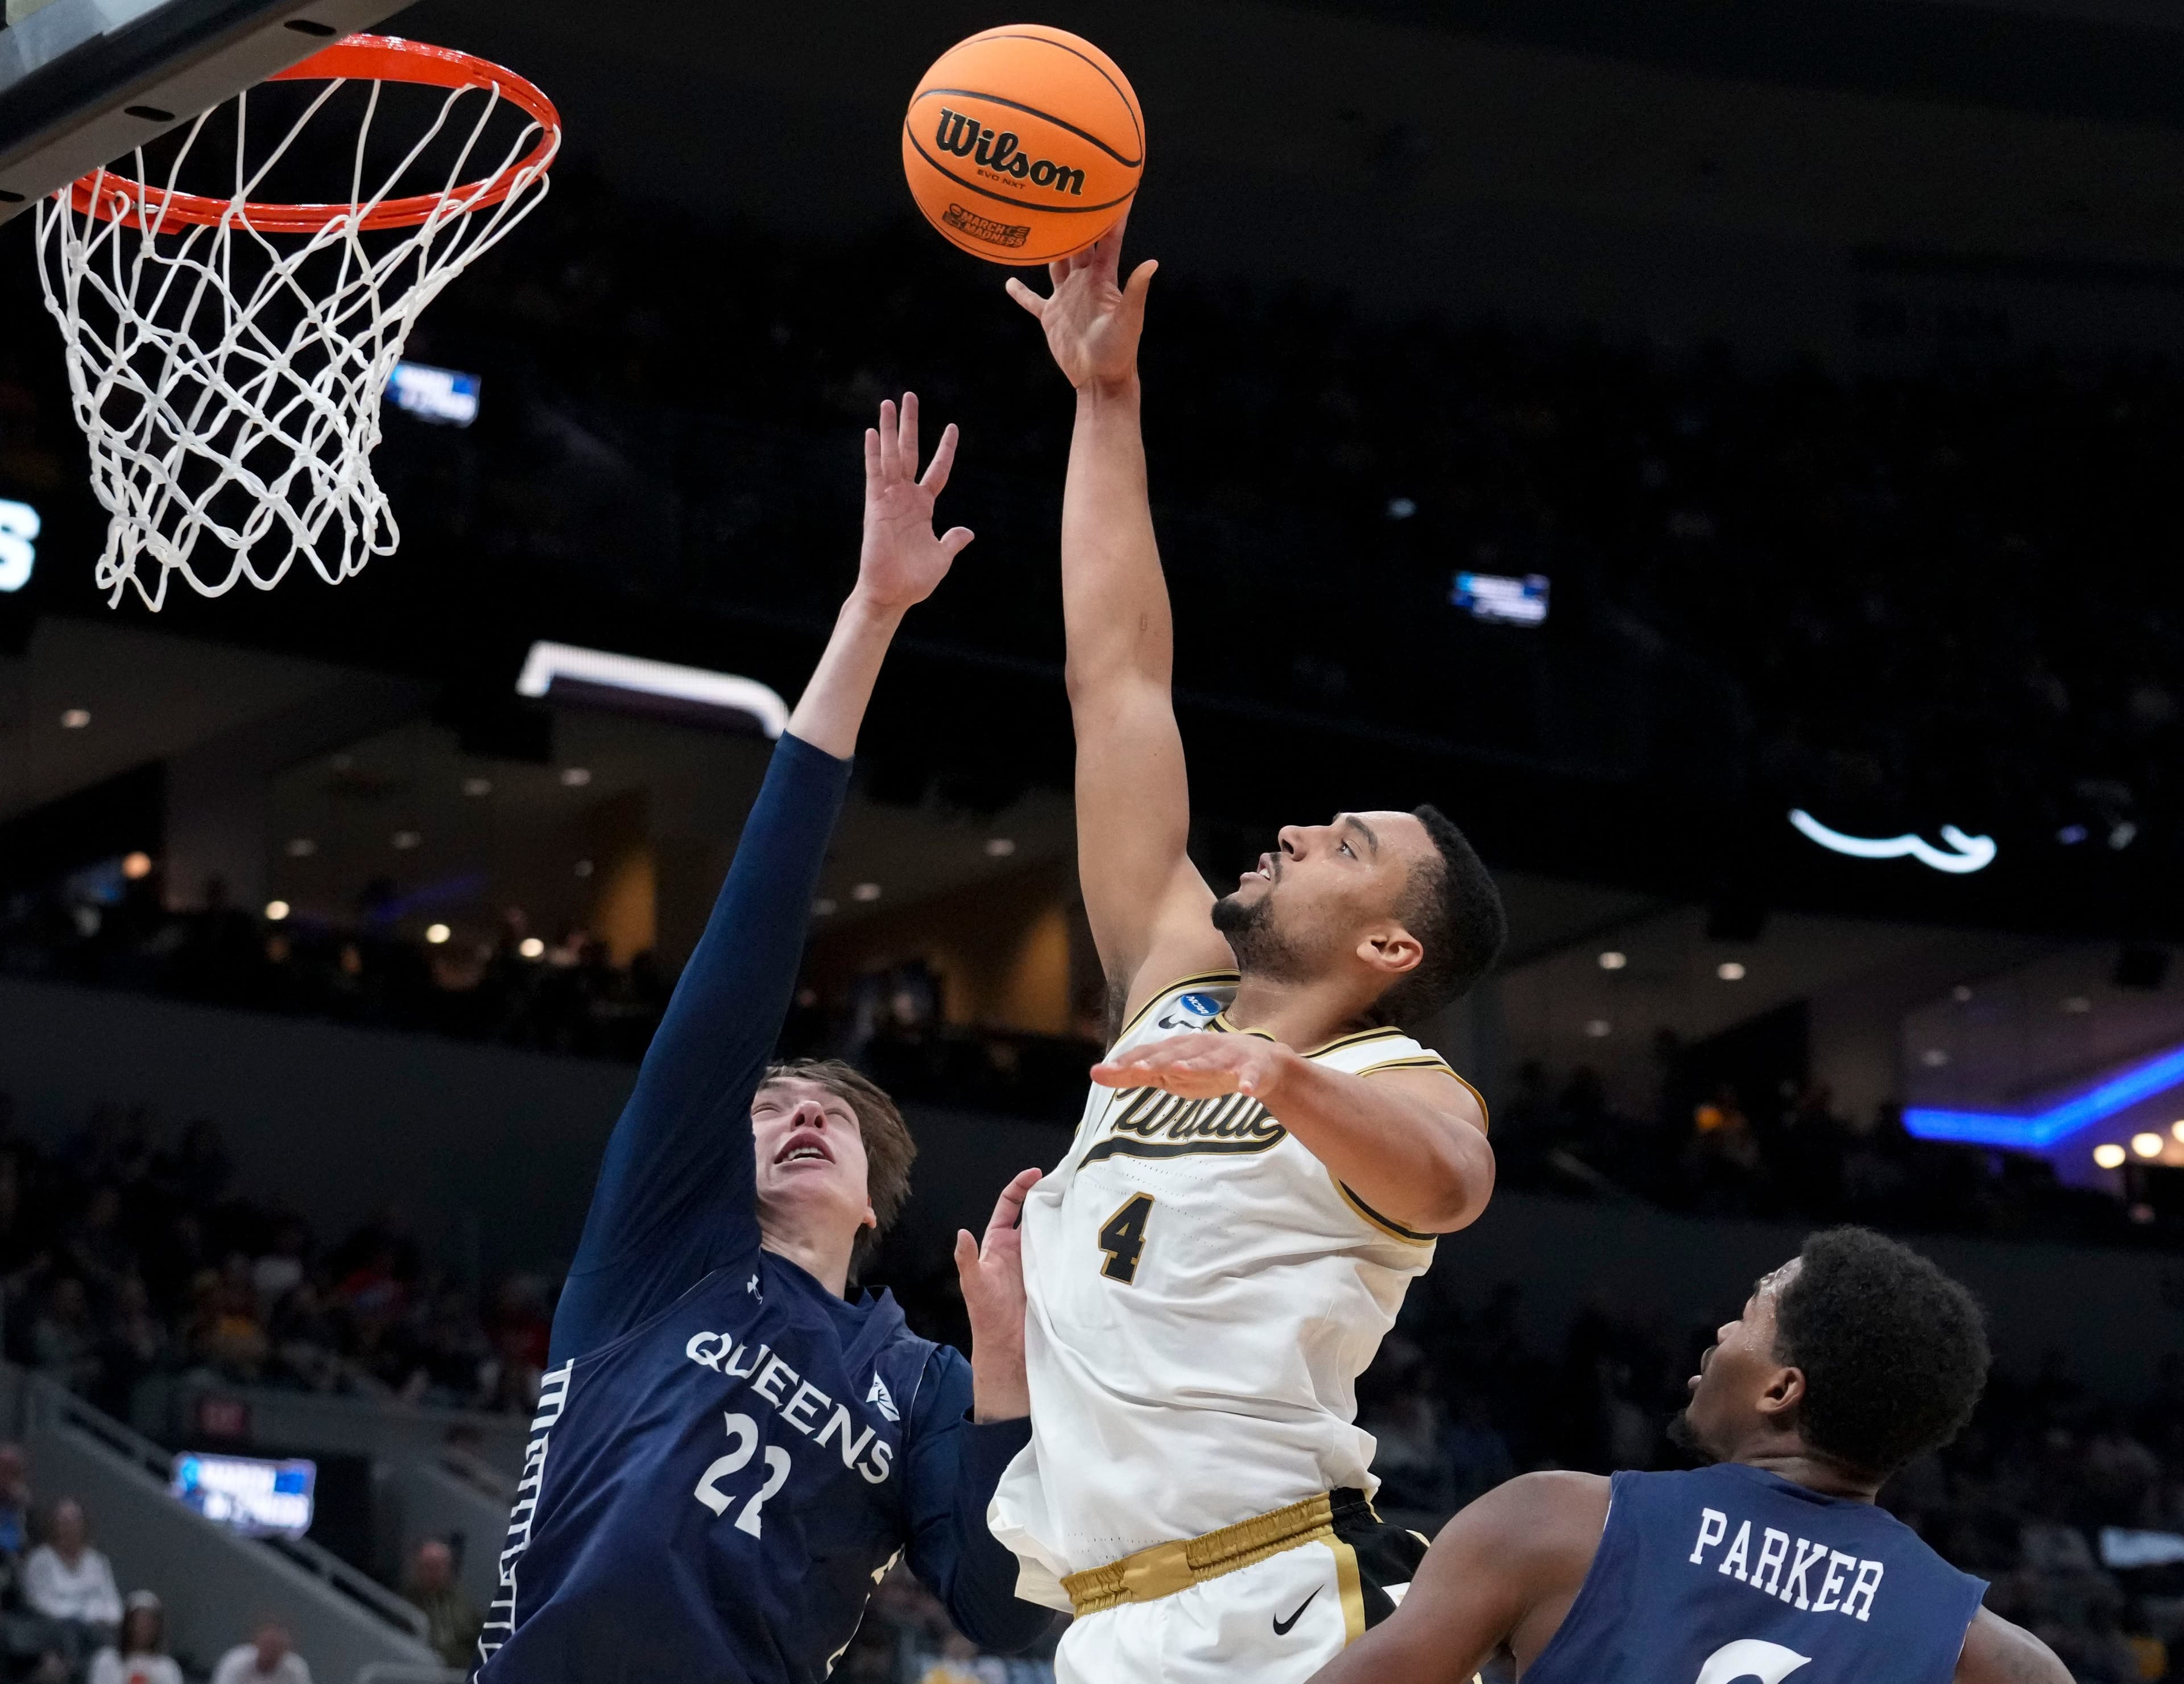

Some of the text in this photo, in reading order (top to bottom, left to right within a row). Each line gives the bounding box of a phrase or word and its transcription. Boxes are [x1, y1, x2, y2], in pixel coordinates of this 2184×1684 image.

[936, 107, 1086, 196] Wilson
[977, 169, 1025, 189] EVO NXT
[961, 212, 1006, 234] MARCH
[1186, 995, 1210, 1014] NCAA
[1098, 1191, 1155, 1285] 4
[686, 1331, 894, 1484] QUEENS
[694, 1411, 791, 1540] 22
[1689, 1508, 1884, 1622] PARKER
